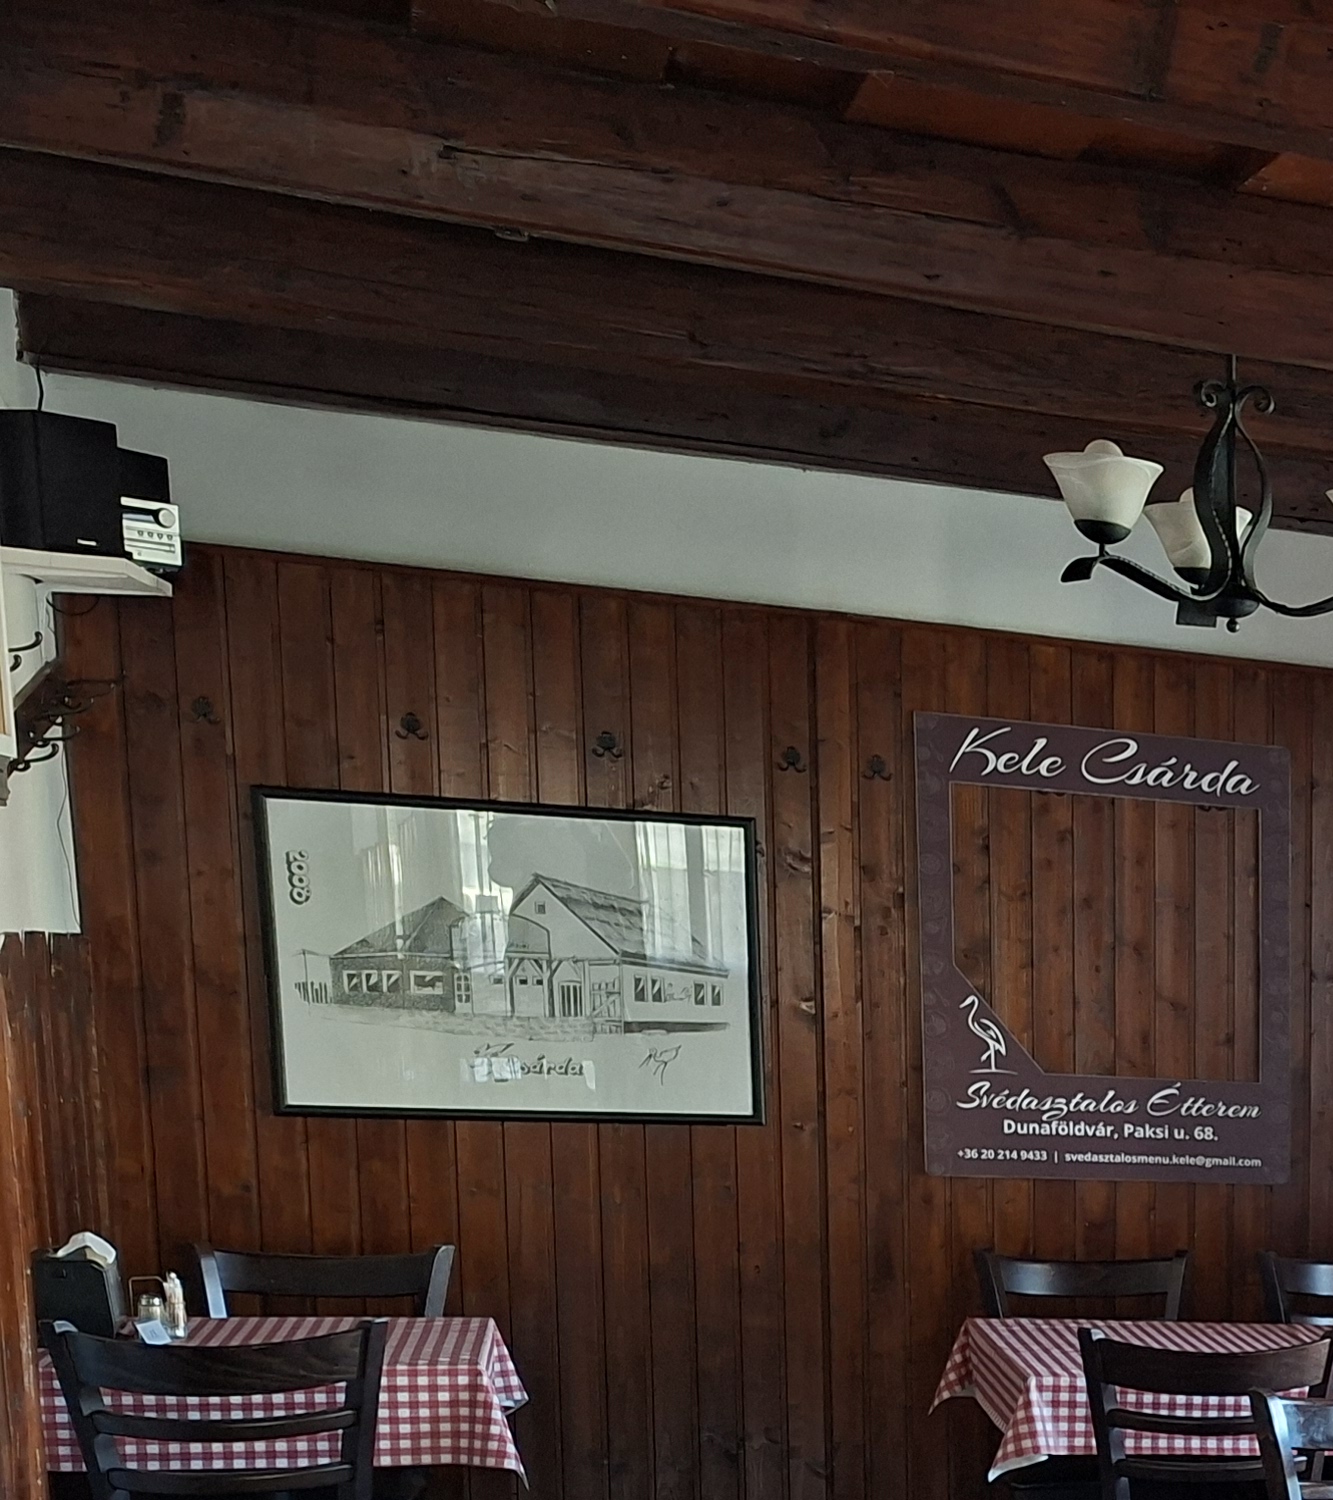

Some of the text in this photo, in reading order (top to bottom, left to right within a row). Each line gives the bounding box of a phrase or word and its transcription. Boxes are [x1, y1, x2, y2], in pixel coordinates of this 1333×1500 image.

[949, 726, 1261, 798] Kele Csárda
[956, 1080, 1262, 1121] Svédasztalos Étterem
[1003, 1118, 1219, 1141] Dunaföldvár, Paksi u. 68.
[957, 1148, 1262, 1168] +36 20 214 9433 svedasztalosmenu.kele@gmail.com
